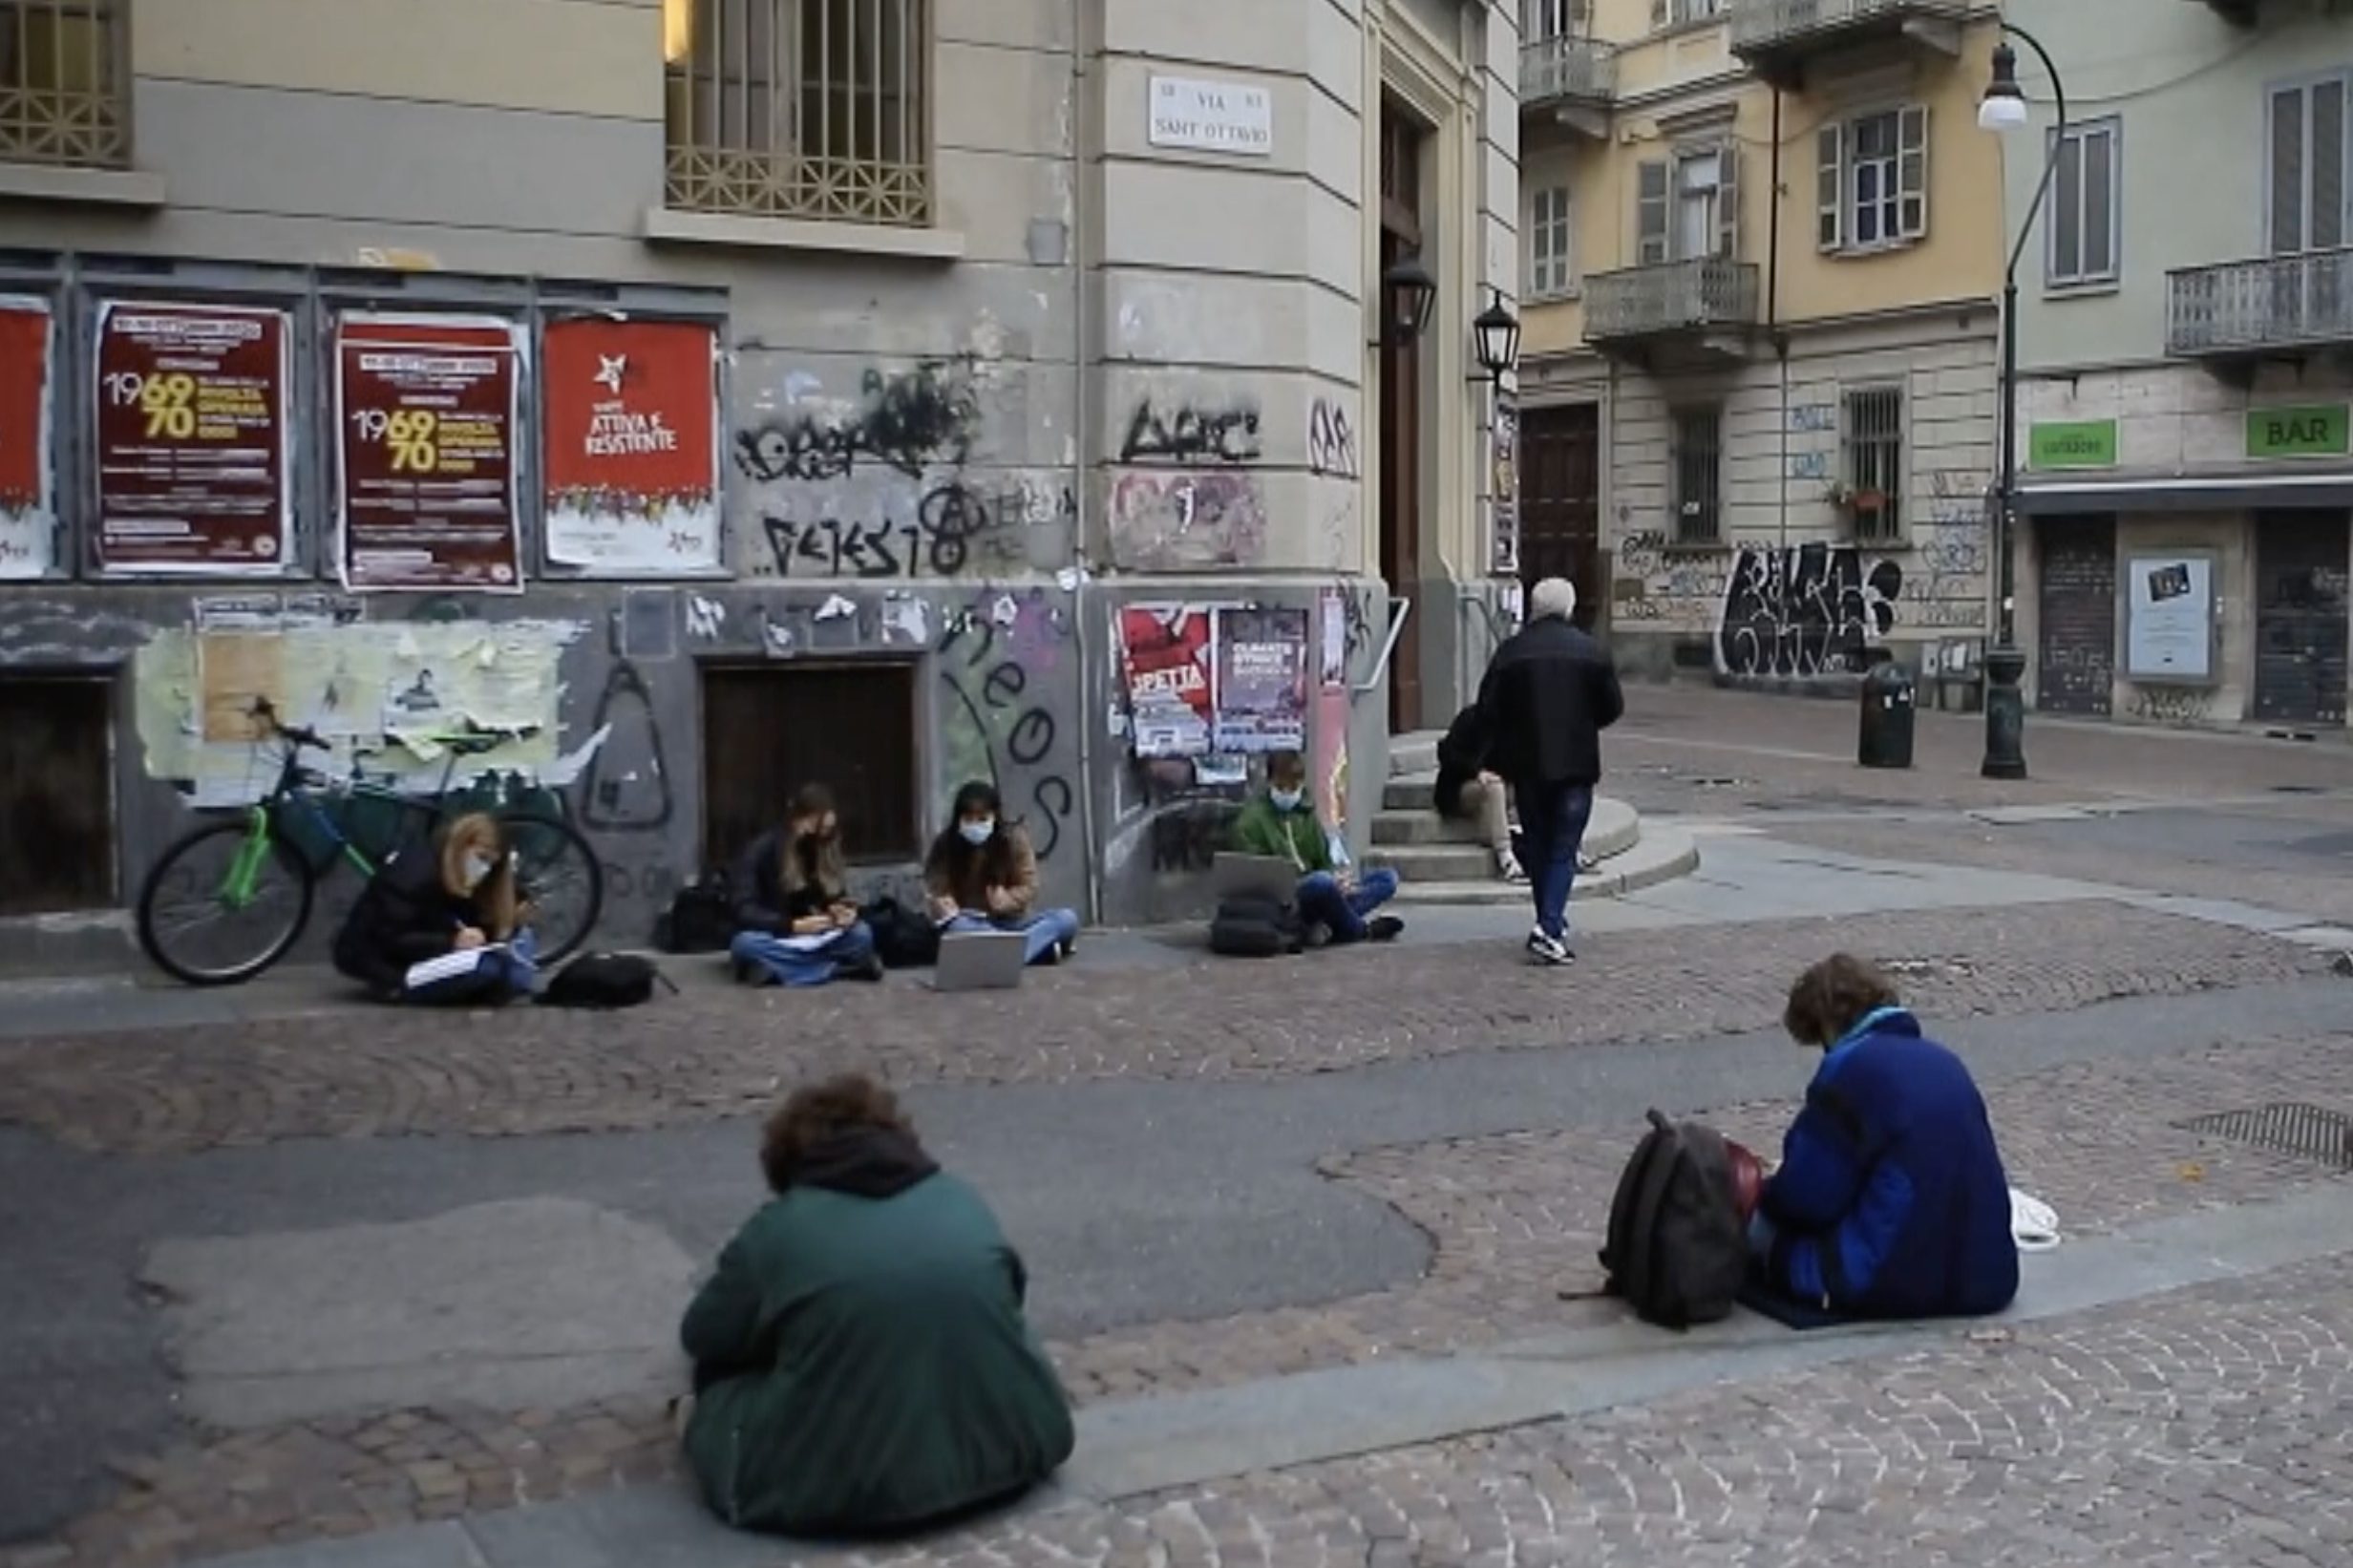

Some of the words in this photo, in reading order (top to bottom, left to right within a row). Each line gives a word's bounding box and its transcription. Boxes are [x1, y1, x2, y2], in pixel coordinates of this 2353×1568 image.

[1197, 92, 1226, 112] VIA
[141, 406, 196, 439] 70
[590, 413, 650, 436] ATTIVA
[2266, 418, 2330, 446] BAR
[387, 440, 436, 474] 70
